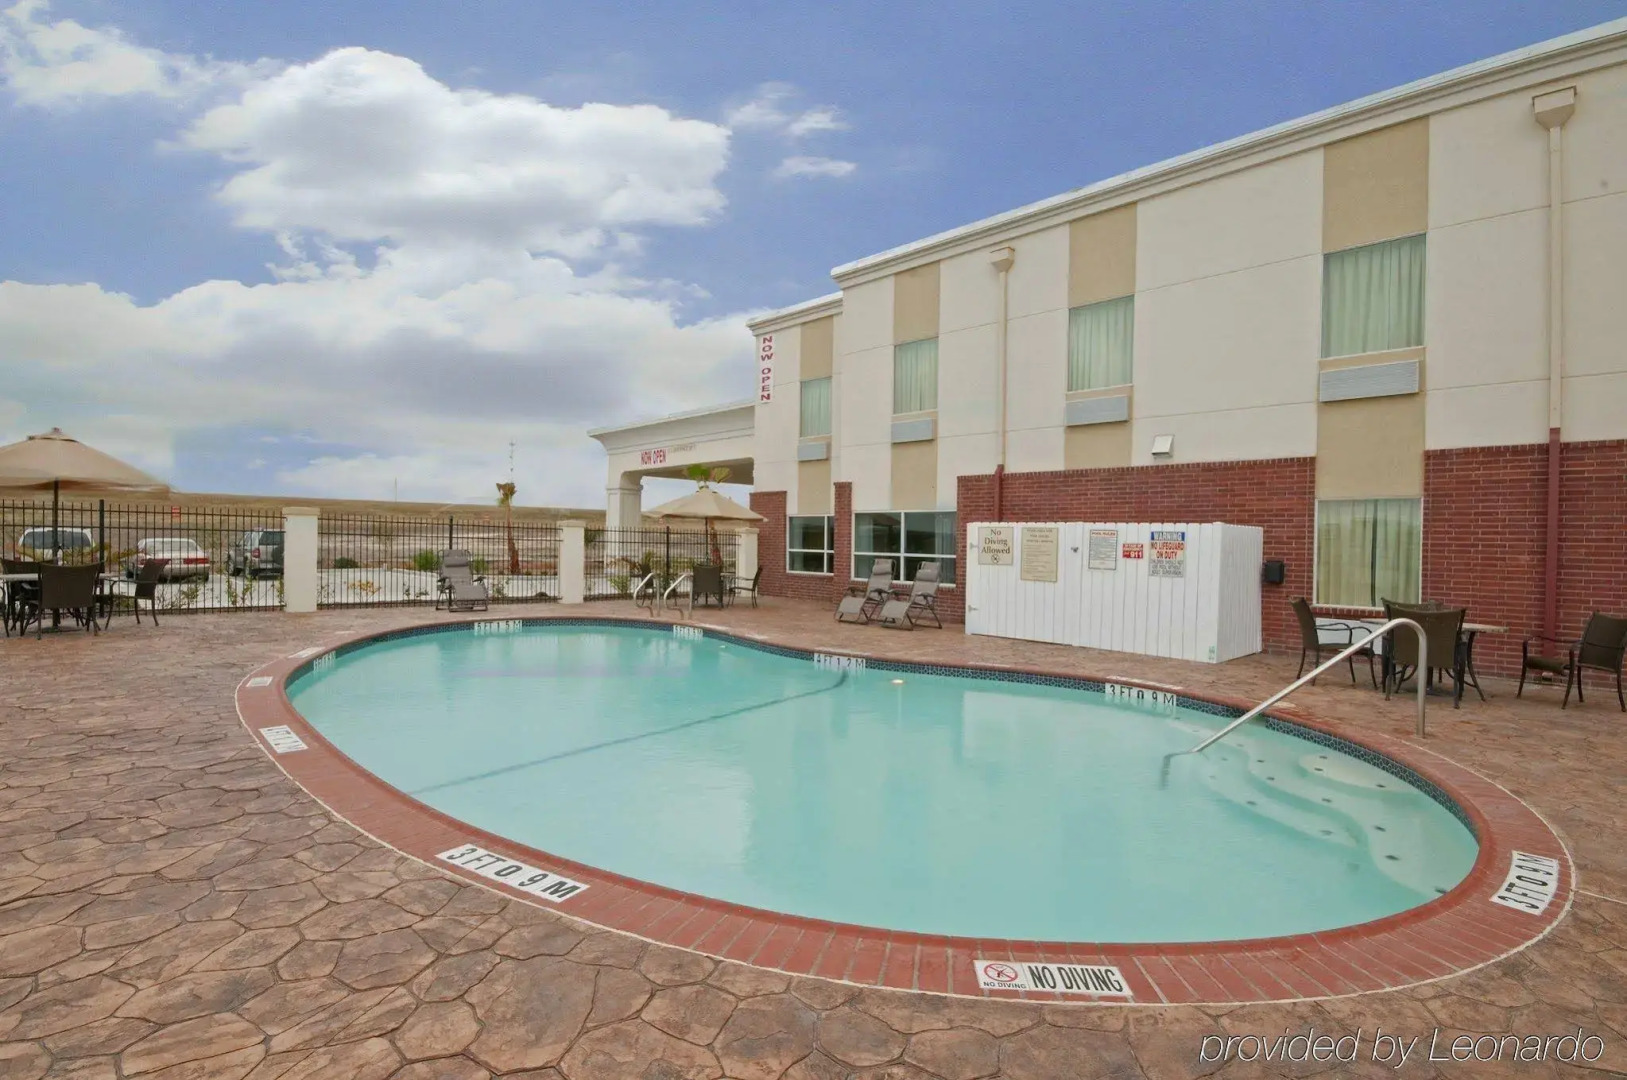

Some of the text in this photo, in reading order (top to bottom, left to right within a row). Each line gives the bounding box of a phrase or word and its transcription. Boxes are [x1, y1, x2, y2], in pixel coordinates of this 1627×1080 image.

[761, 336, 773, 401] NOW OPEN
[641, 449, 666, 465] NOW OPEN
[984, 537, 1008, 547] Diving
[1153, 532, 1182, 540] WARNING
[981, 546, 1010, 554] Allowed
[1151, 542, 1184, 550] NO LIFEGUARD
[1164, 551, 1178, 559] DUTY
[1109, 684, 1116, 695] 3
[1120, 686, 1133, 698] FT
[1152, 691, 1158, 702] 9
[1163, 693, 1174, 705] M
[446, 847, 478, 860] 3
[460, 853, 508, 870] FT
[518, 873, 549, 887] 9
[540, 880, 582, 899] M
[1027, 965, 1124, 993] NO DIVING
